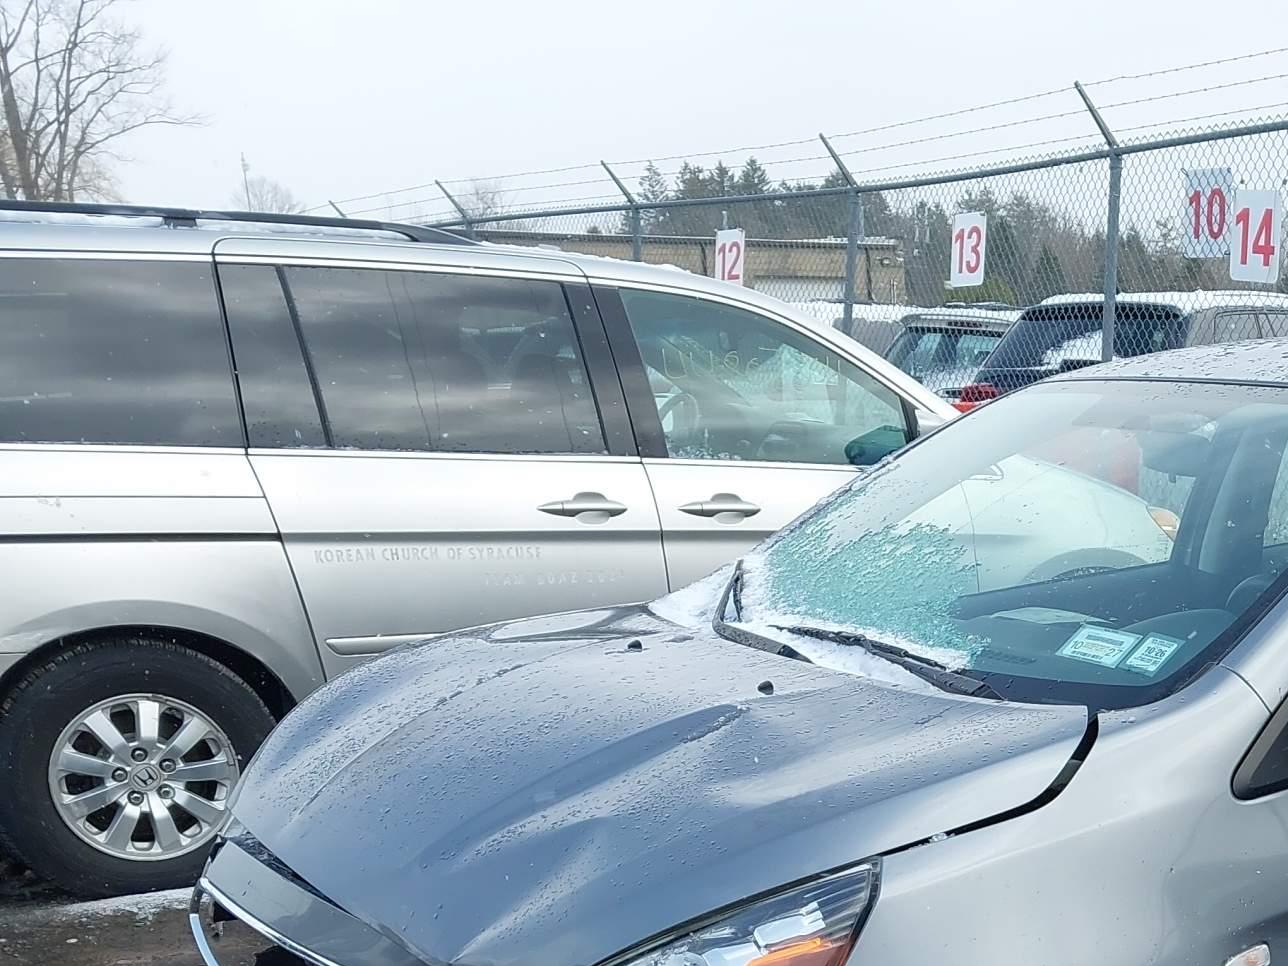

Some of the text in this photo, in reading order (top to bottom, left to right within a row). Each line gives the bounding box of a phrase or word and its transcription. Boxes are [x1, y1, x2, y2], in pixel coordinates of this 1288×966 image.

[1189, 187, 1226, 240] 10
[1235, 207, 1275, 267] 14
[717, 241, 741, 281] 12
[954, 225, 982, 274] 13
[314, 546, 543, 564] KOREAN CHURCH OF SYRACUSE
